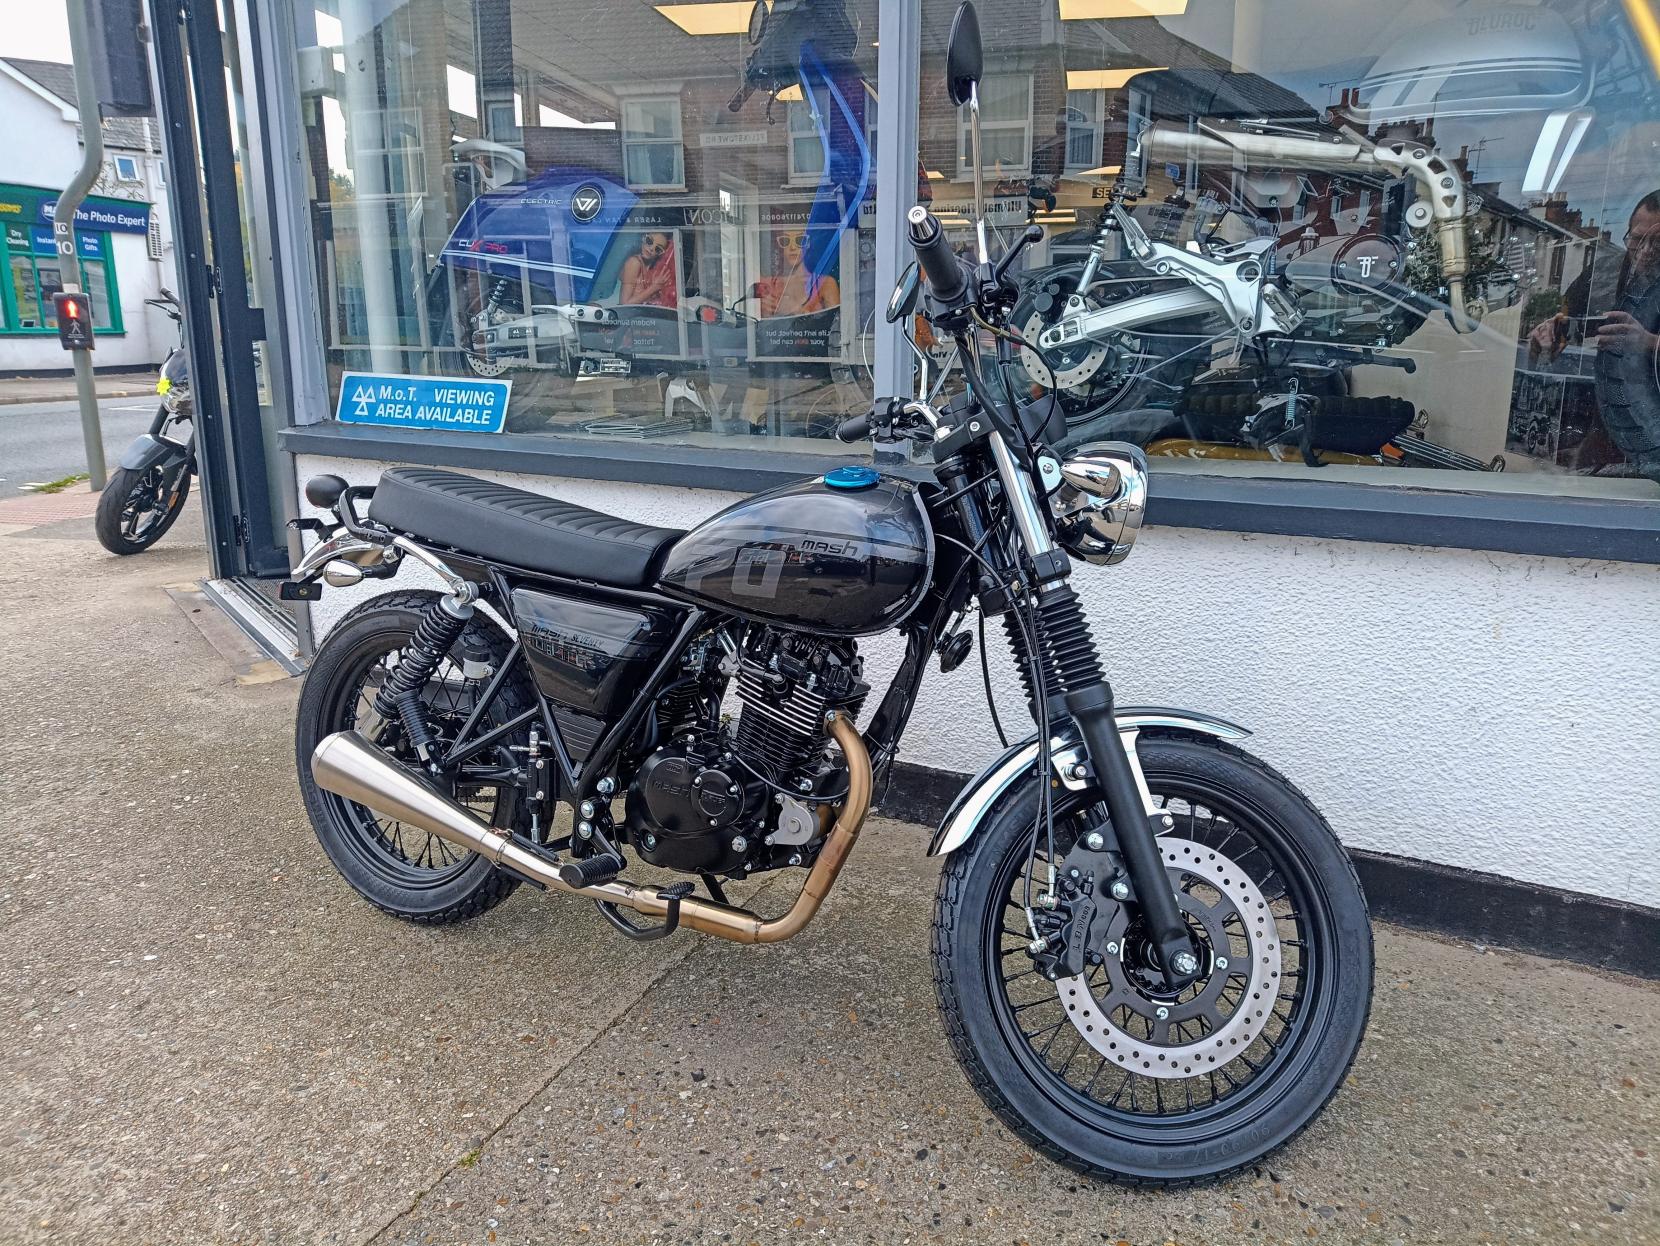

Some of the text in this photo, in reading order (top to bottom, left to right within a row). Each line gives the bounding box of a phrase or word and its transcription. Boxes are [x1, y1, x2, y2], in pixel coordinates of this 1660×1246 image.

[90, 211, 116, 223] Photo
[117, 214, 146, 227] Expert
[56, 223, 68, 233] 10
[82, 236, 98, 244] Photo
[57, 241, 74, 255] 10
[378, 385, 495, 406] M.o.T. VIEWING
[375, 403, 492, 425] AREA AVAILABLE
